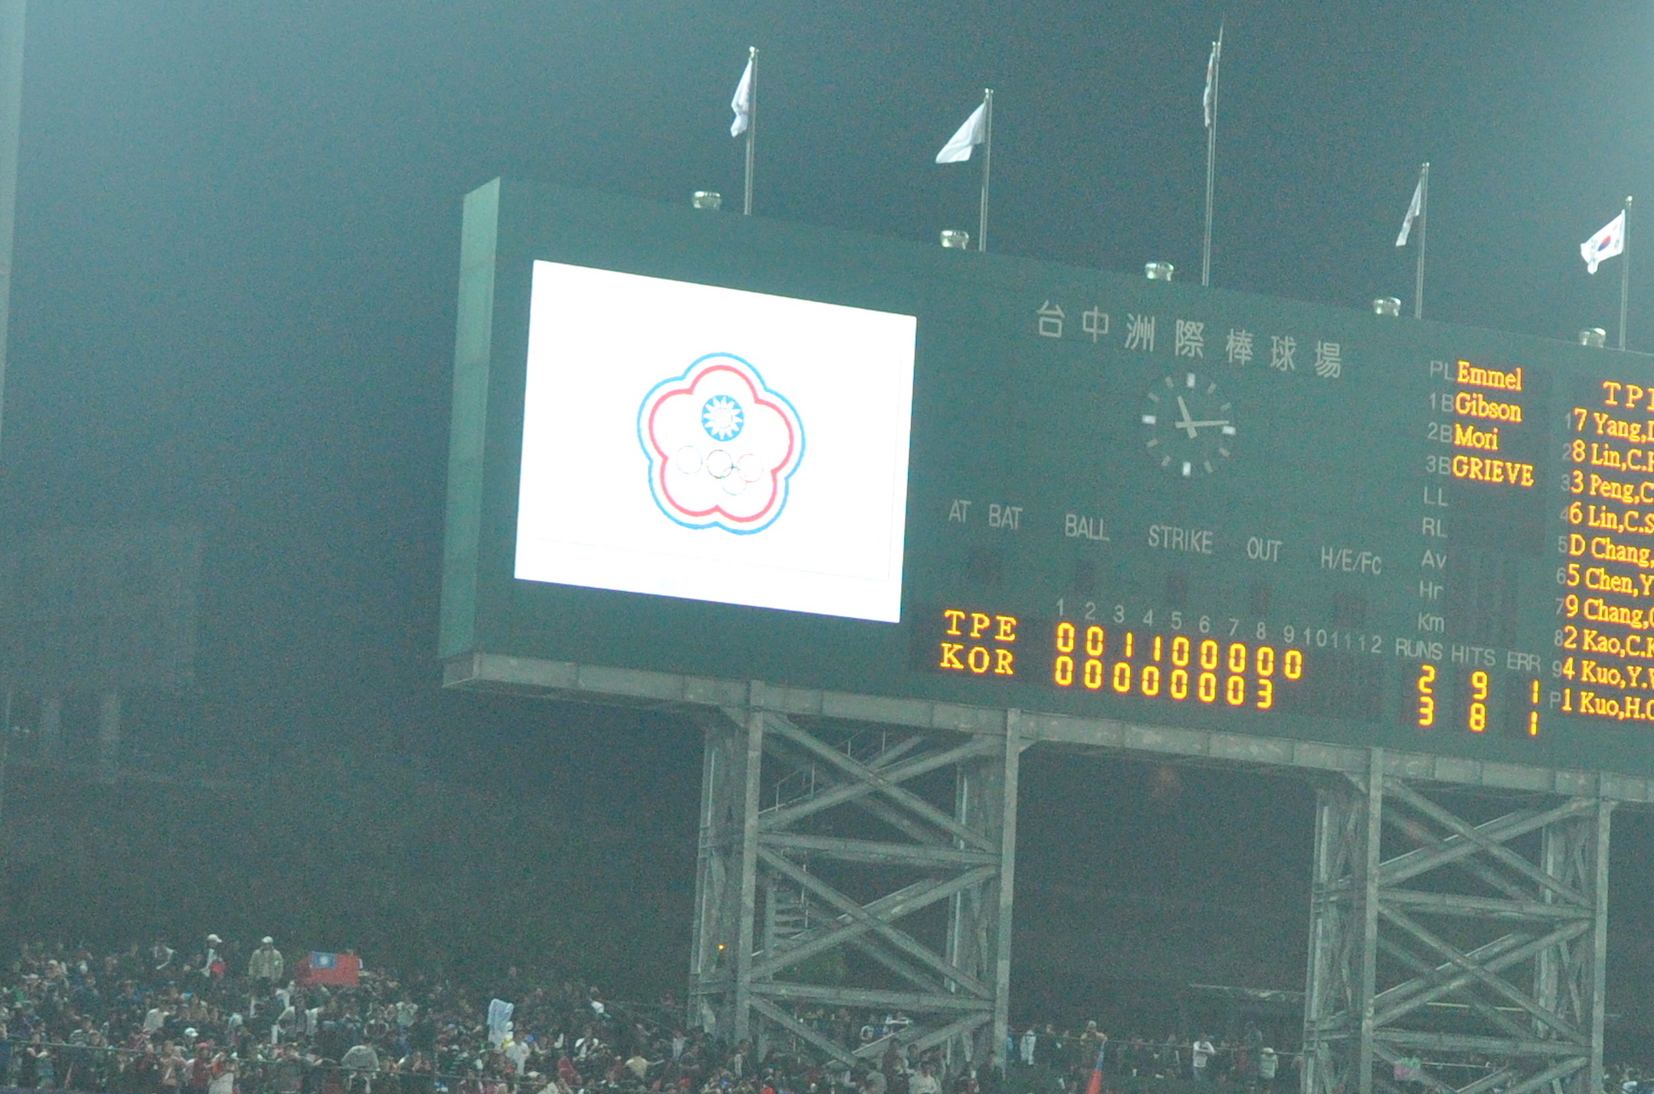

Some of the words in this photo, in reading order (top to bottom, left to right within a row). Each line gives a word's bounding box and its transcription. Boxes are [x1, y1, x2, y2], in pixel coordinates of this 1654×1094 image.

[1036, 300, 1342, 379] 台中洲際棒球場
[1430, 360, 1454, 380] PL
[1457, 360, 1522, 391] Emmel
[1429, 392, 1454, 412] 1B
[1455, 391, 1522, 422] Gibson
[1574, 407, 1587, 431] 7
[1427, 422, 1453, 443] 2B
[1454, 423, 1499, 451] Mori
[1572, 439, 1586, 462] 8
[1425, 455, 1451, 475] 3B
[1452, 455, 1535, 487] GRIEVE
[1570, 470, 1584, 493] 3
[1423, 486, 1449, 507] LL
[949, 500, 972, 523] AT
[988, 503, 1024, 530] BAT
[1569, 501, 1583, 524] 6
[1065, 514, 1110, 541] BALL
[1148, 524, 1214, 555] STRIKE
[1422, 517, 1448, 538] RL
[1246, 536, 1283, 562] OUT
[1569, 533, 1586, 556] D
[1567, 563, 1580, 587] 5
[1419, 580, 1444, 600] Hr
[1565, 594, 1579, 617] 9
[944, 609, 1017, 642] TPE
[1417, 611, 1445, 632] Km
[1563, 625, 1578, 649] 2
[939, 642, 1014, 675] KOR
[1395, 638, 1443, 661] RUNS
[1451, 644, 1497, 666] HITS
[1506, 651, 1541, 672] ERR
[1562, 656, 1576, 680] 4
[1418, 664, 1436, 694] 2
[1471, 670, 1488, 700] 9
[1562, 688, 1572, 712] 1
[1418, 695, 1435, 726] 3
[1469, 702, 1486, 732] 8
